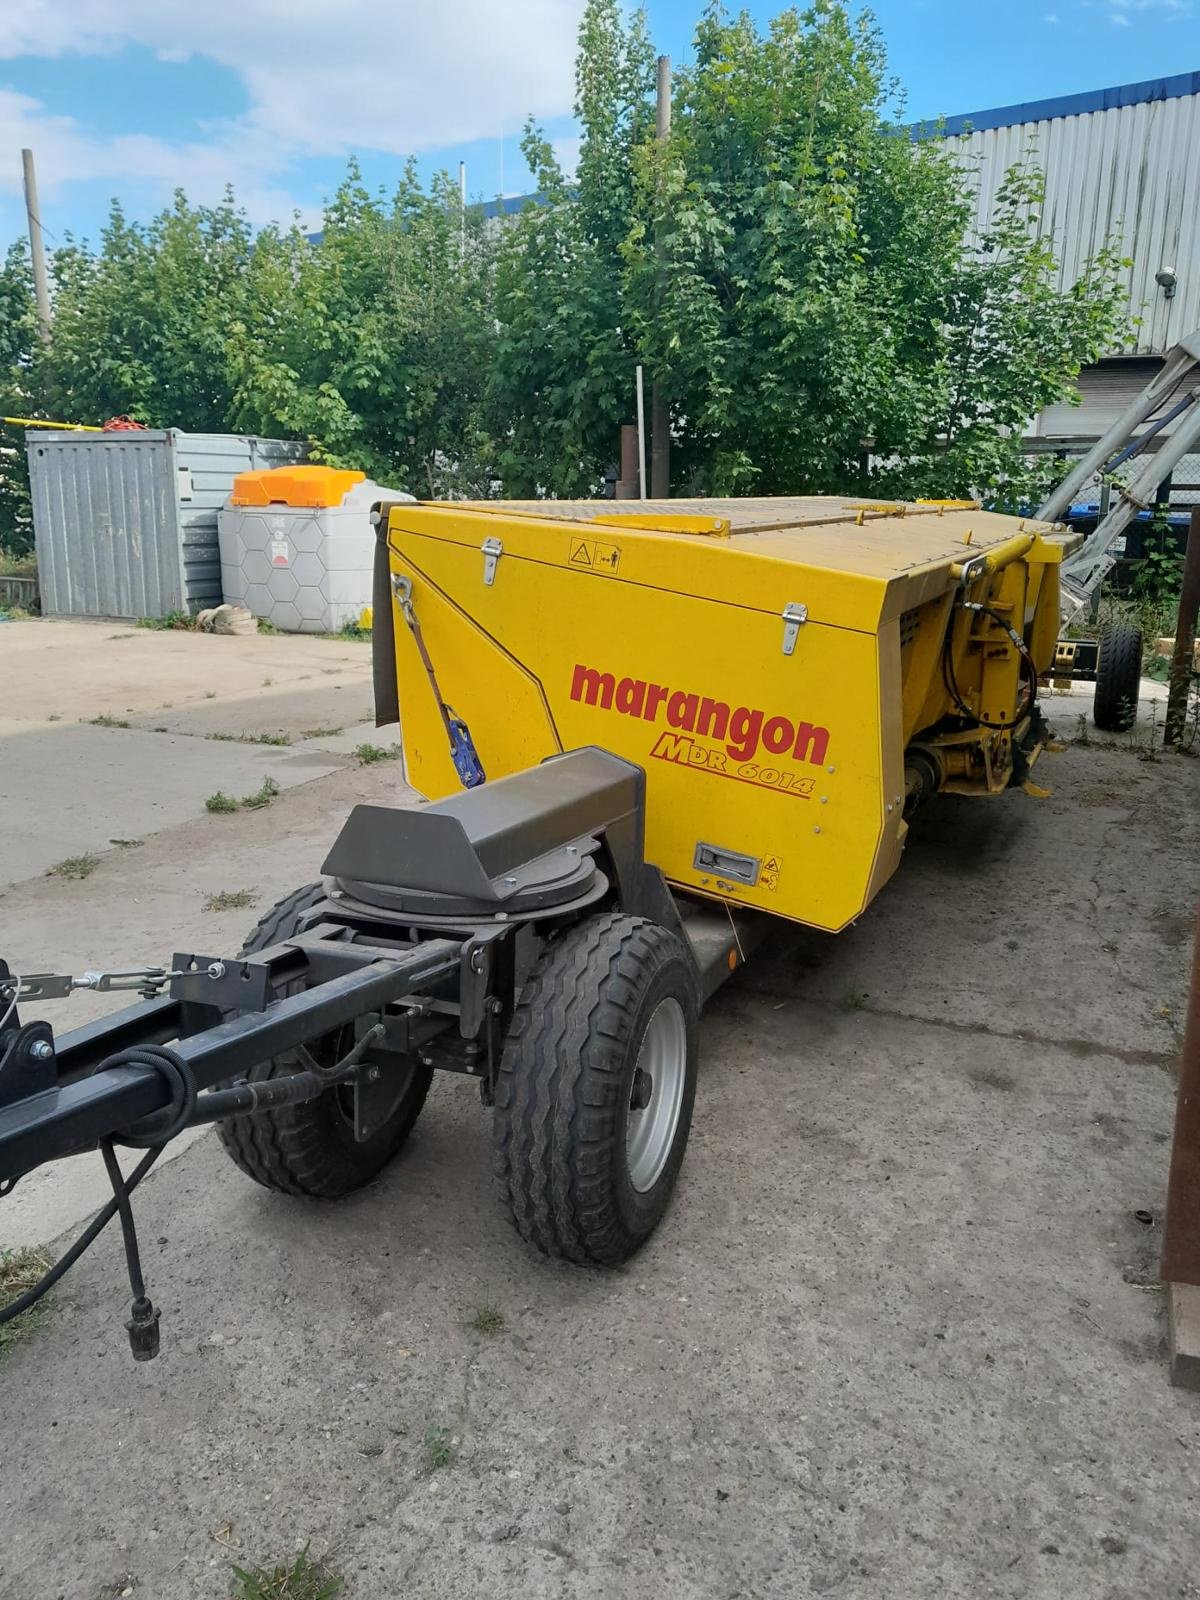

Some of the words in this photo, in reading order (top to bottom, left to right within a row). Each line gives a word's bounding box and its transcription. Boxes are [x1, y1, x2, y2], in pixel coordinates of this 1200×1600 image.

[570, 664, 830, 766] marangon
[650, 732, 727, 772] MDR
[737, 763, 816, 795] 6014
